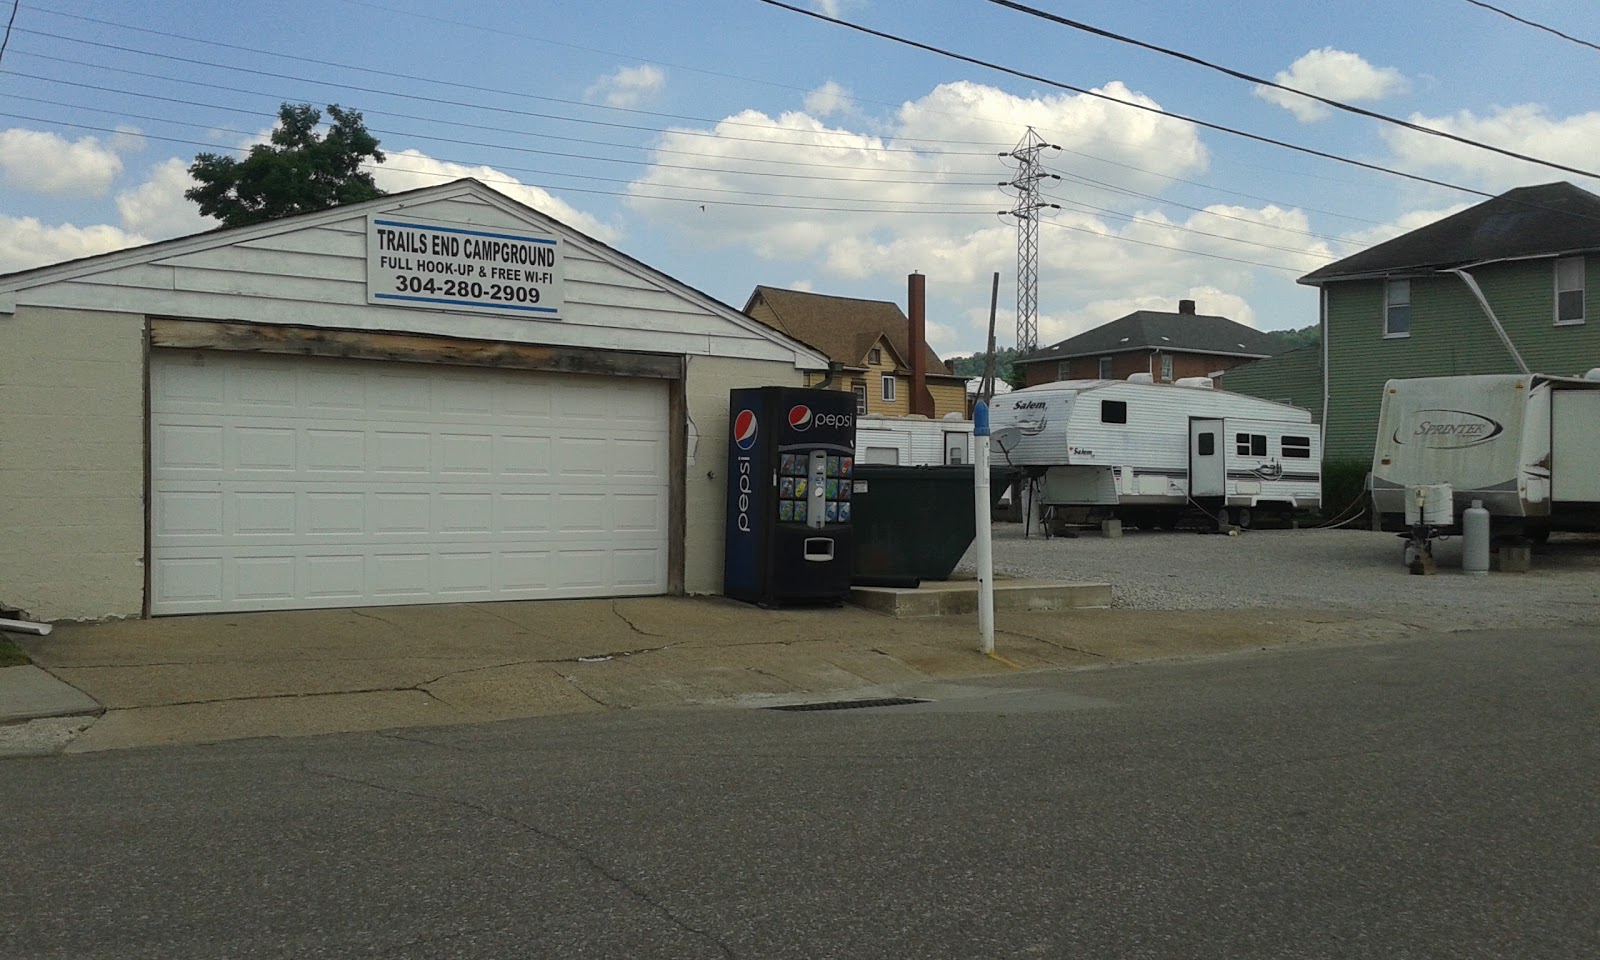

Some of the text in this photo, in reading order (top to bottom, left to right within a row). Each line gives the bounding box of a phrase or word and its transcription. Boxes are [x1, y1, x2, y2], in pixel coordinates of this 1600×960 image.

[377, 229, 555, 267] TRAILS END CAMPGROUND
[380, 256, 553, 284] FULL HOOK-UP & FREE WI-FI
[395, 274, 540, 303] 304-280-2909
[1013, 400, 1046, 410] Salem
[815, 413, 853, 429] pepsi
[1414, 421, 1486, 435] SPRINTER
[738, 456, 752, 532] pepsi
